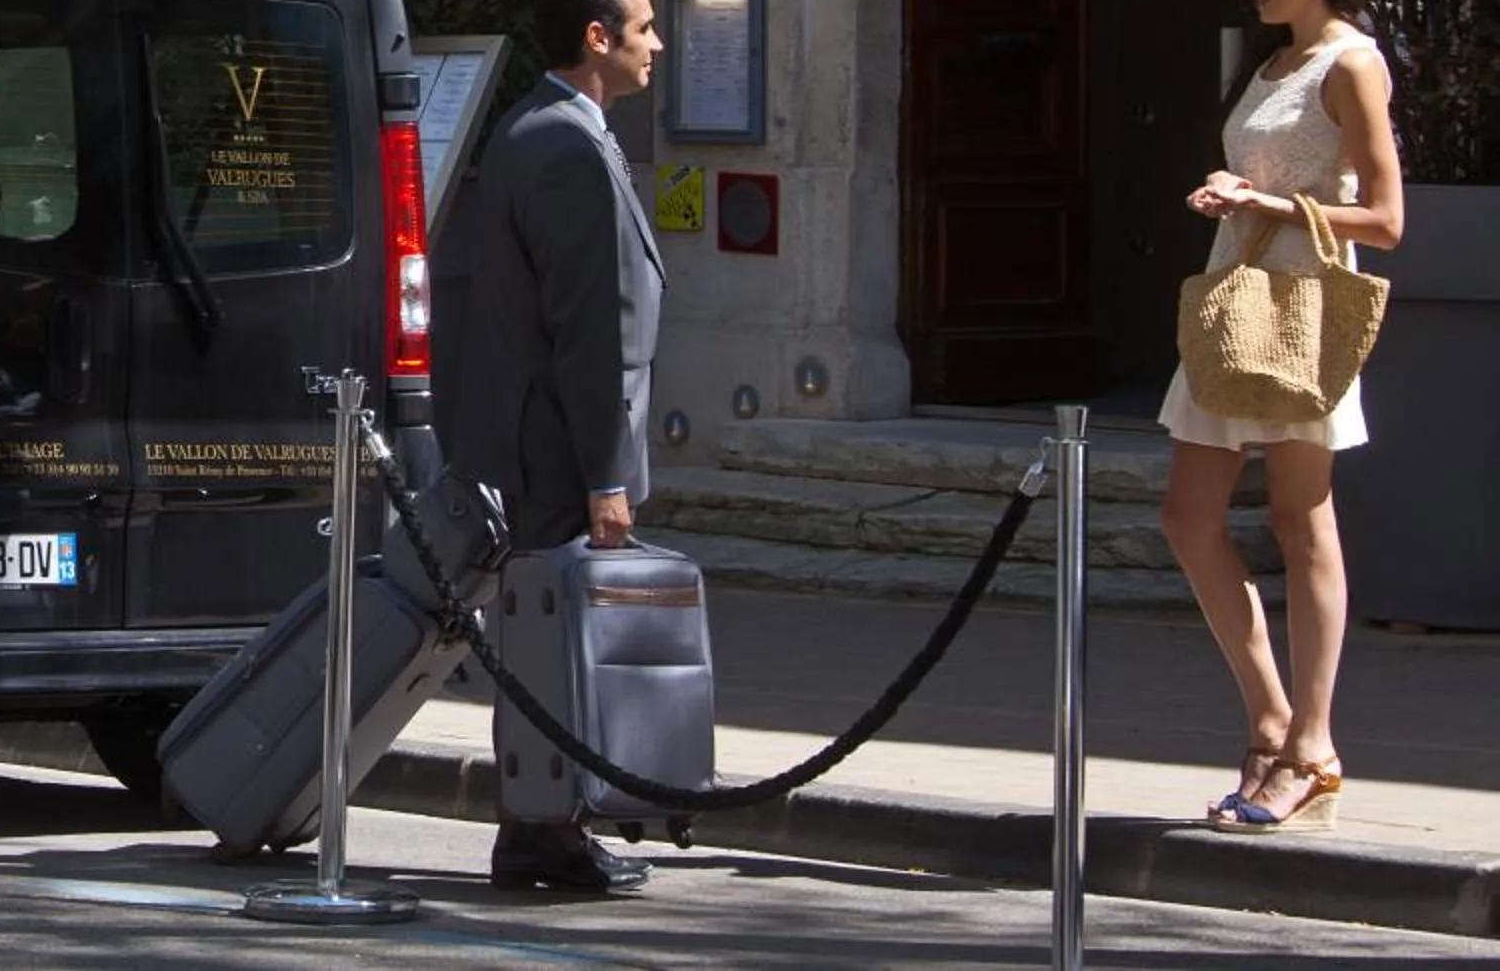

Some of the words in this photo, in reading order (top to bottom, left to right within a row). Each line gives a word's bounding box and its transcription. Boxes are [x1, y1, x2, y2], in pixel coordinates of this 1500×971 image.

[145, 443, 165, 460] LE
[166, 443, 228, 460] VALLON
[231, 443, 253, 460] DE
[254, 444, 337, 462] VALRUGUES
[59, 561, 77, 580] 13
